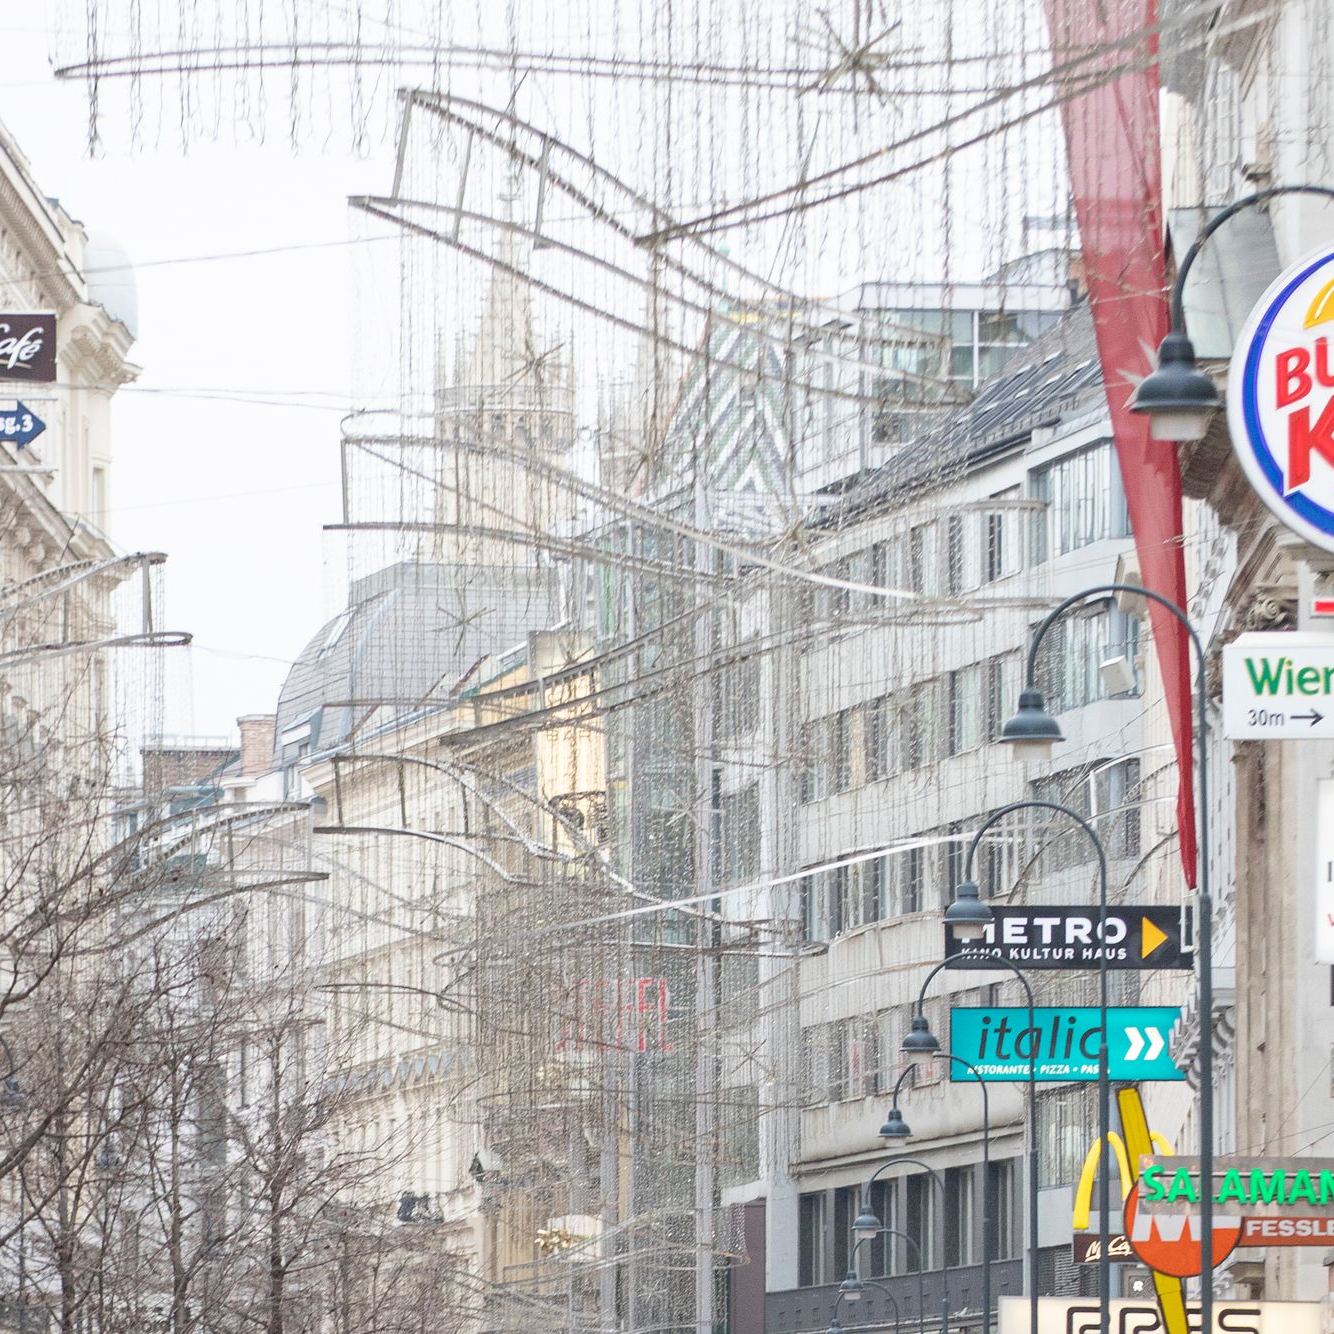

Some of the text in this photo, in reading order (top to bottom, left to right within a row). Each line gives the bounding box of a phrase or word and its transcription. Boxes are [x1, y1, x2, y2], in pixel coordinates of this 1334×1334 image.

[1248, 709, 1284, 727] 30m
[1010, 948, 1075, 961] KULTUR
[1082, 948, 1128, 961] HAUS
[1040, 1064, 1071, 1075] PIZZA
